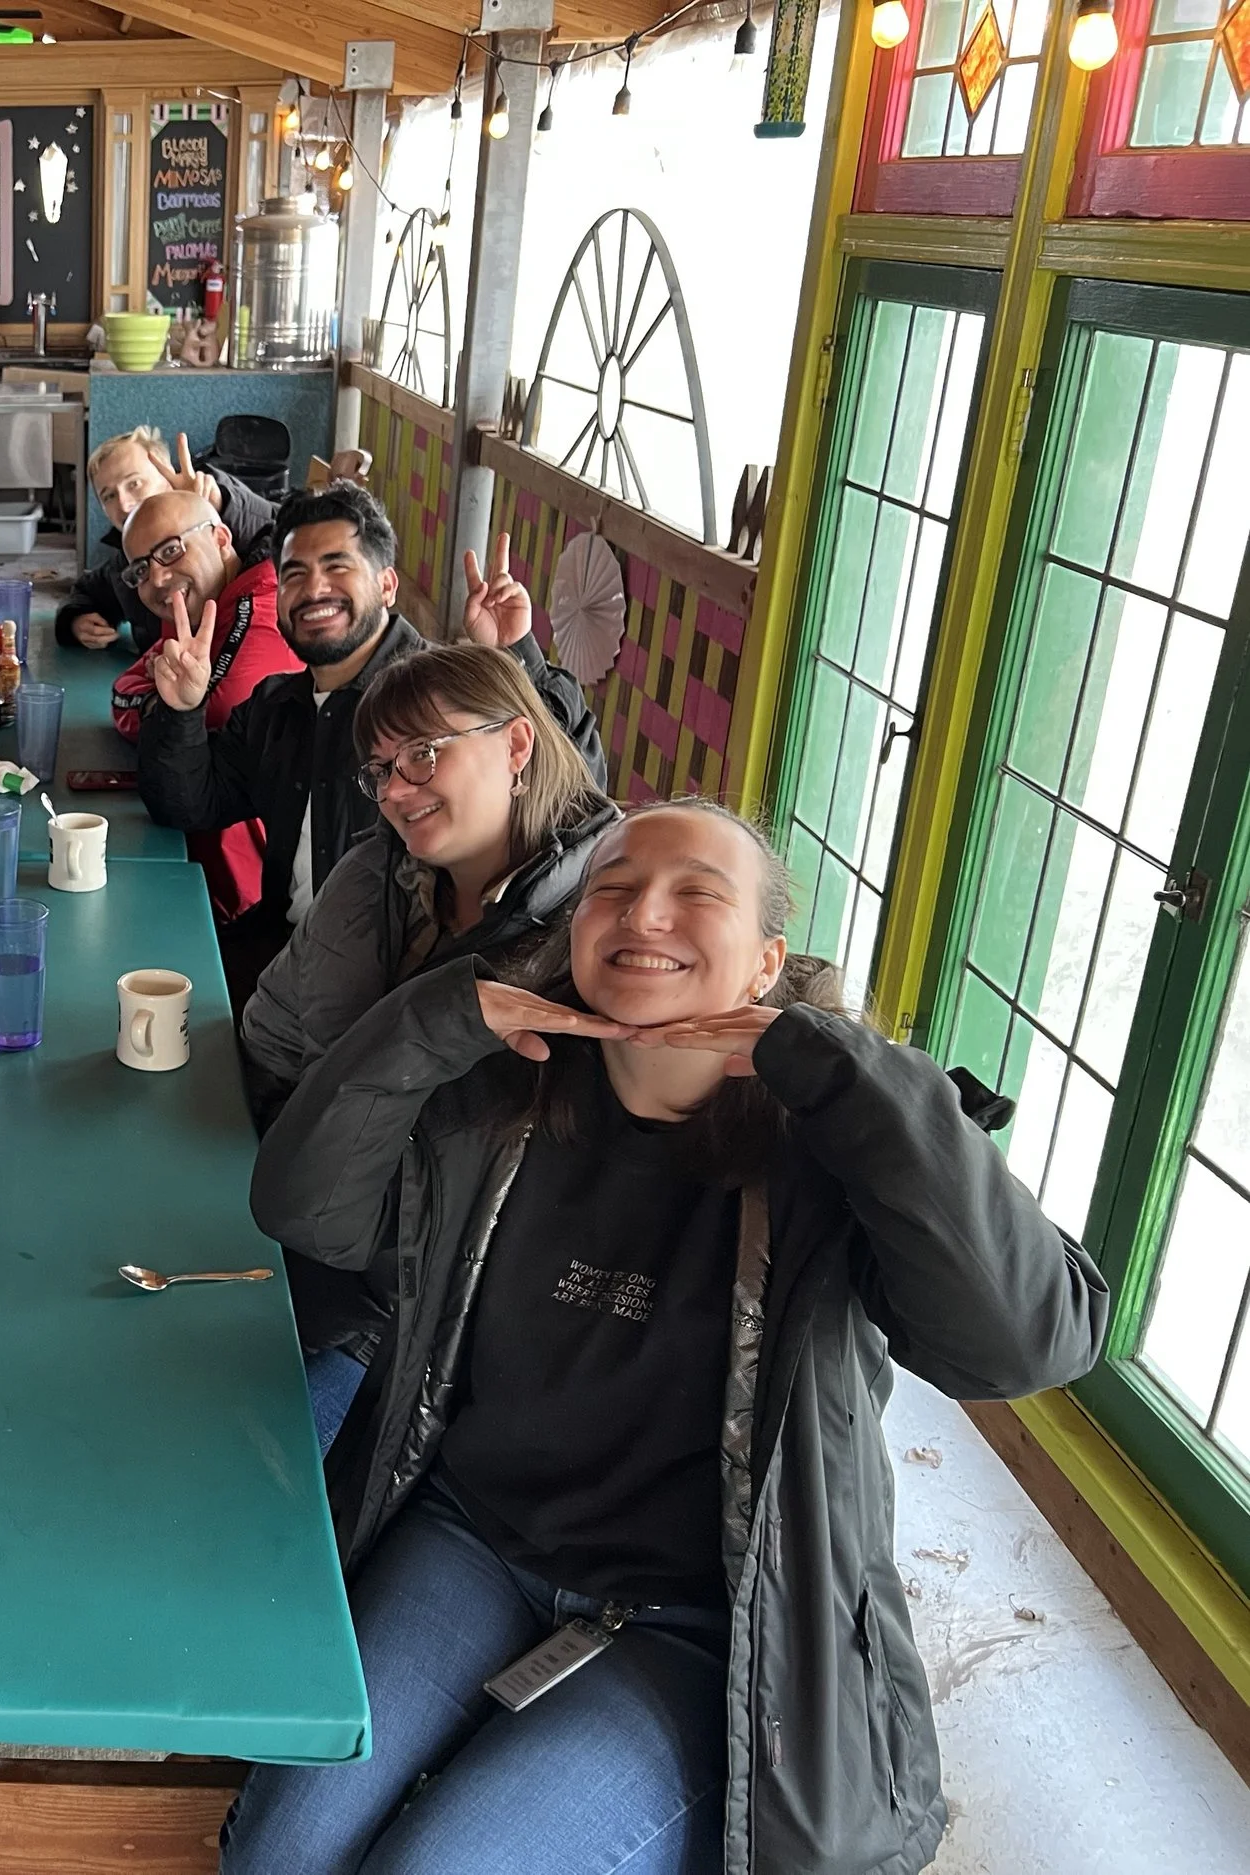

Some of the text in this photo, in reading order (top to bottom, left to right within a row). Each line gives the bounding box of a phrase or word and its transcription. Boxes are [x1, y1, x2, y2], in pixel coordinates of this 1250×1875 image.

[568, 1272, 584, 1283] IN
[558, 1279, 597, 1298] WHERE
[551, 1291, 576, 1303] ARE
[612, 1304, 650, 1322] MADE
